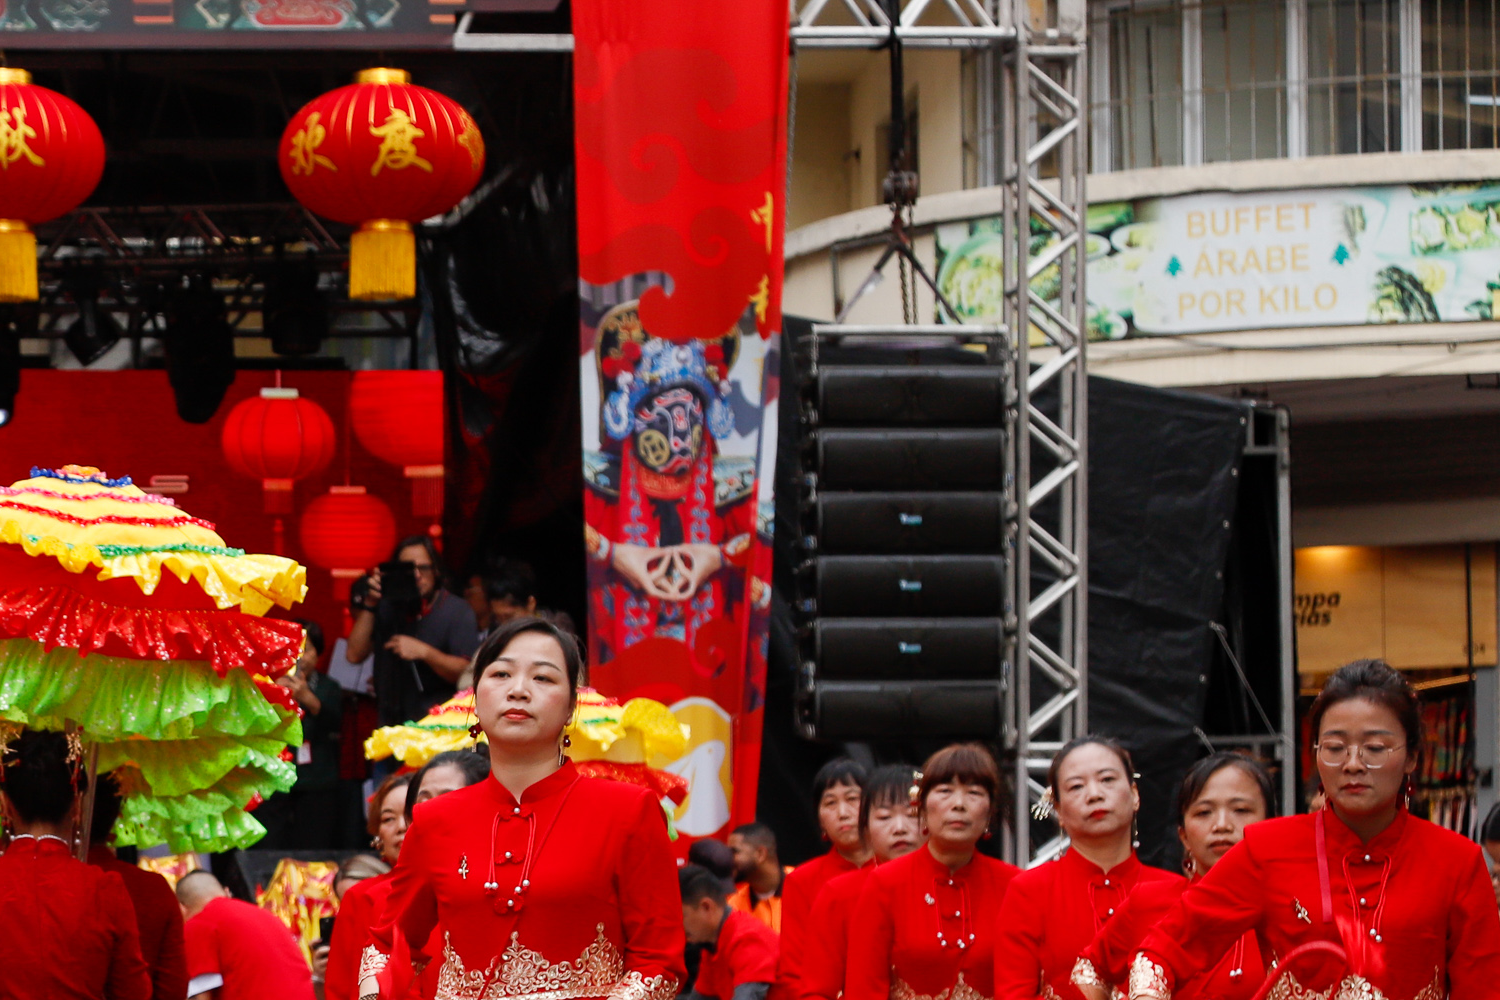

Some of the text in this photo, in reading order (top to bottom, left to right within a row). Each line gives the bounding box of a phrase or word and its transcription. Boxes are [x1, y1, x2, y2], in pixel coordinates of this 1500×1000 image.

[1186, 202, 1316, 239] BUFFET
[1193, 242, 1310, 279] ÁRABE
[1178, 283, 1338, 319] POR KILO
